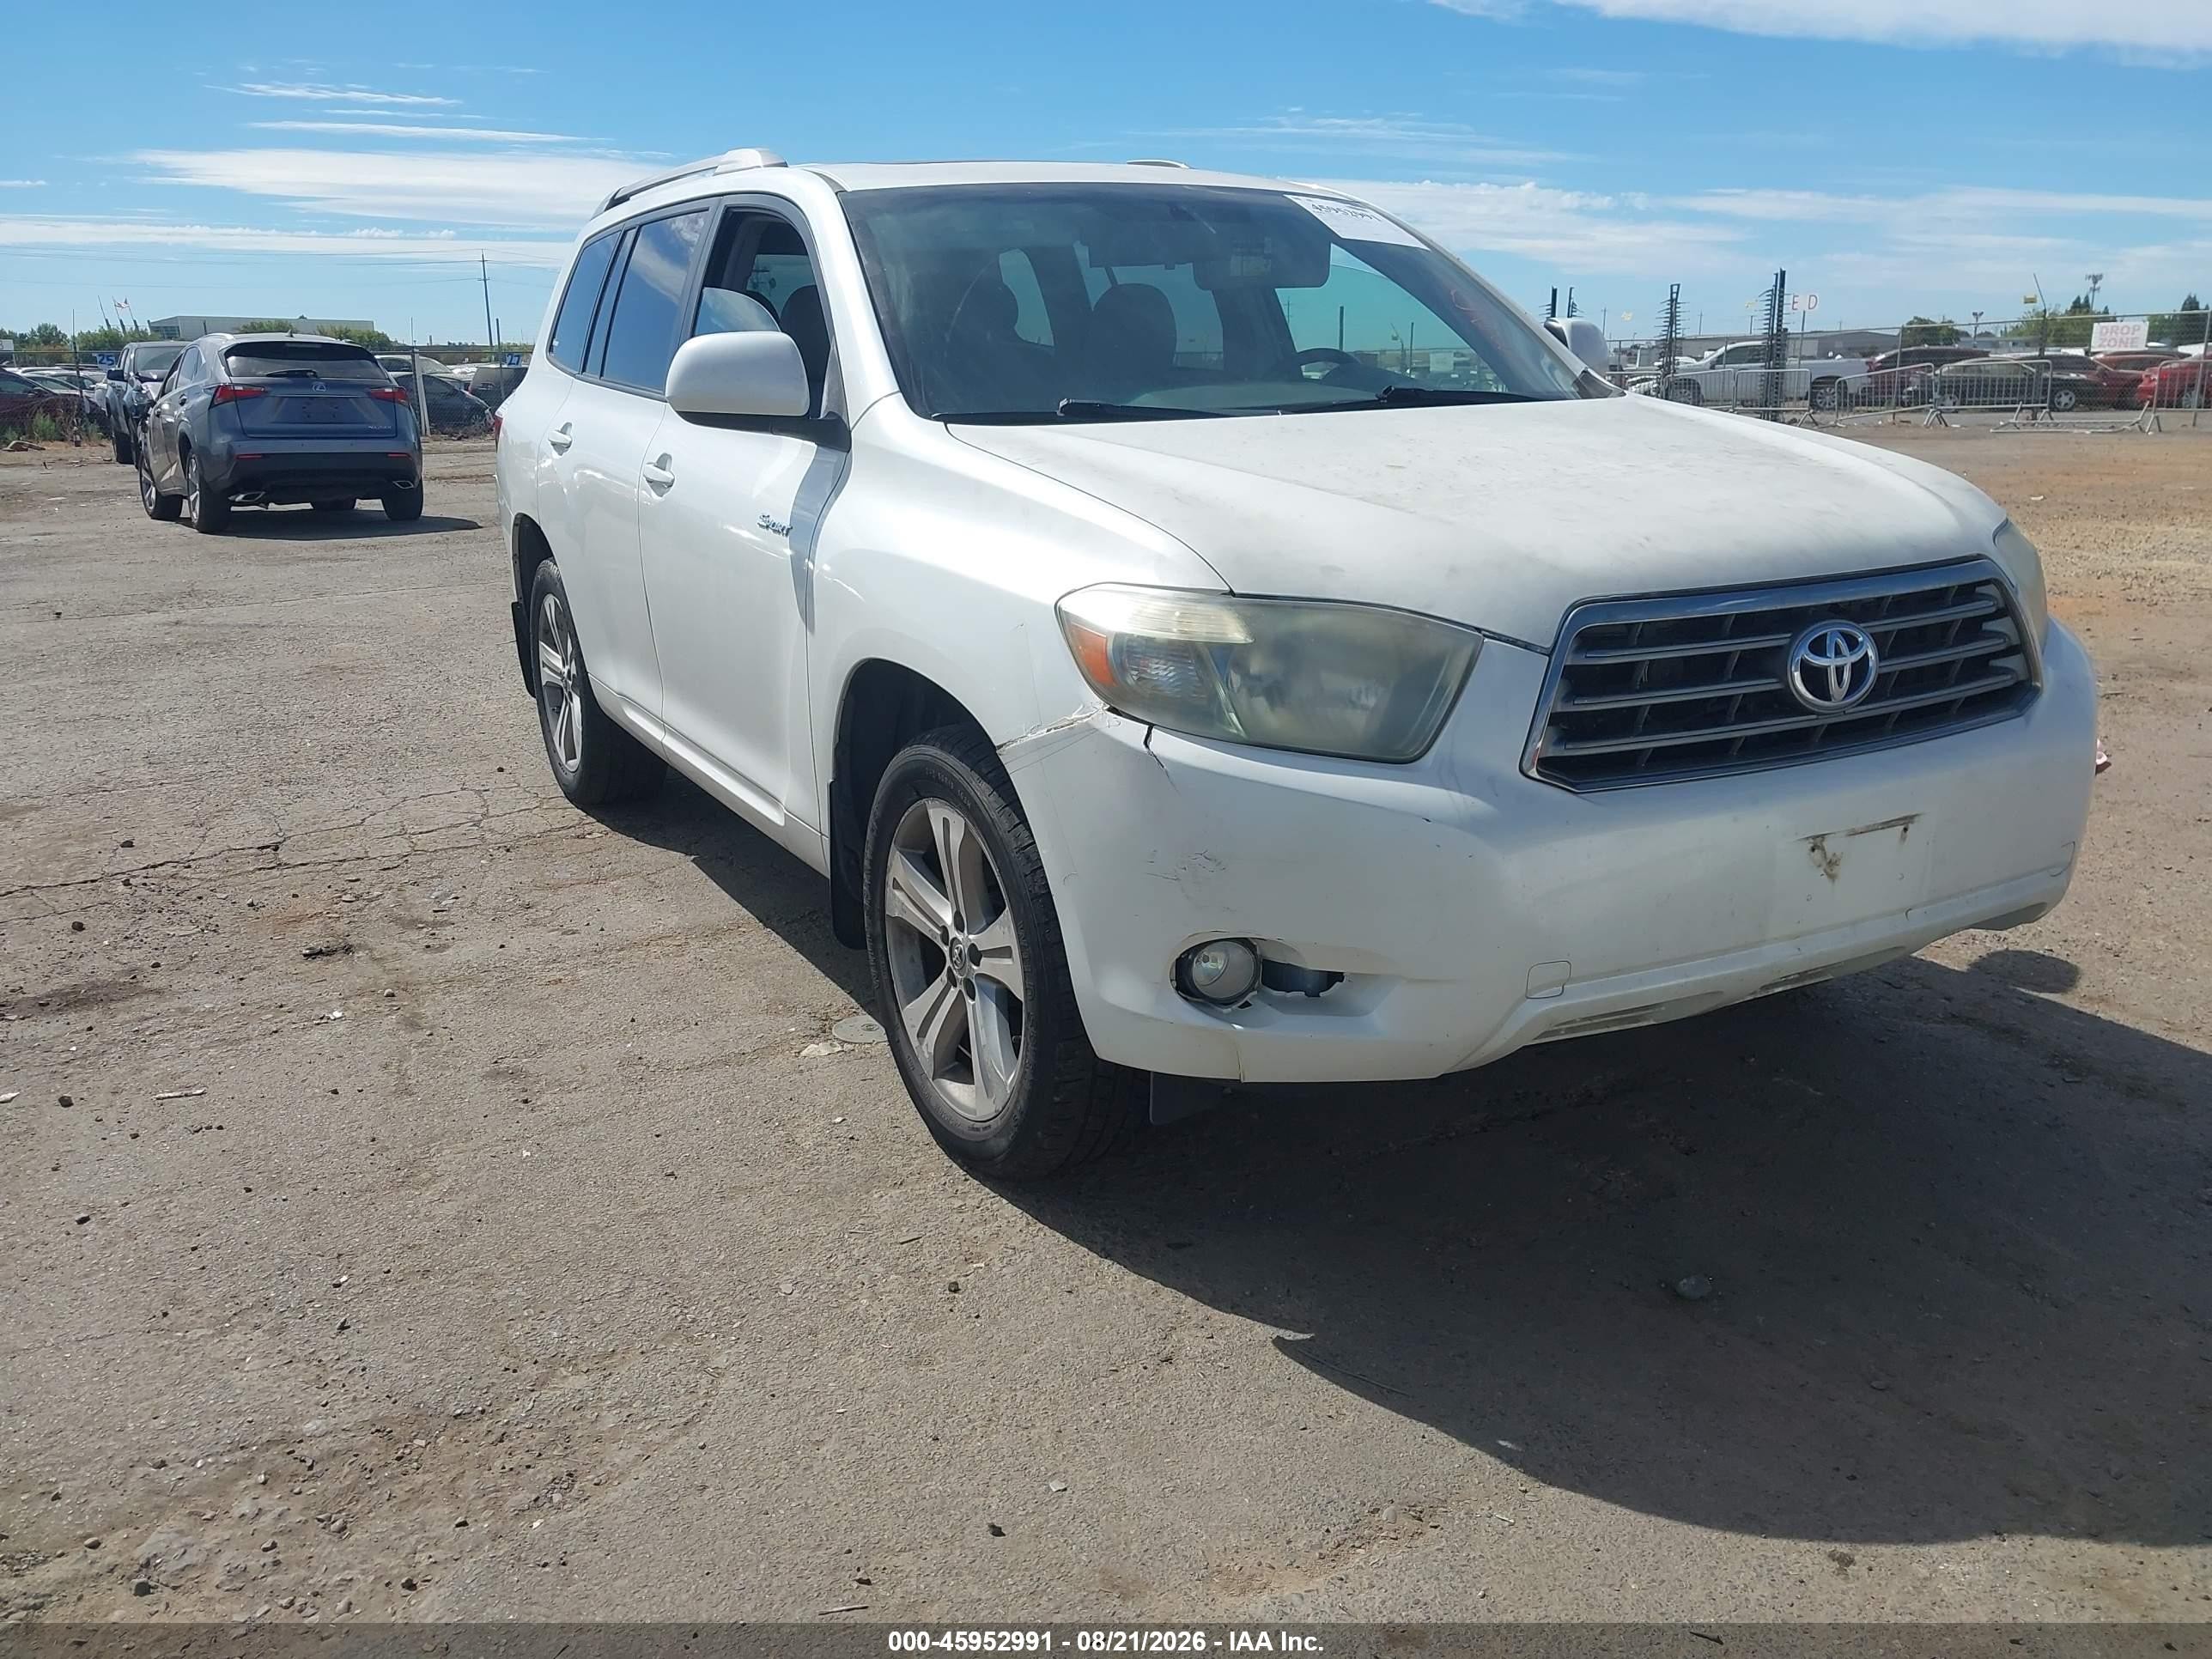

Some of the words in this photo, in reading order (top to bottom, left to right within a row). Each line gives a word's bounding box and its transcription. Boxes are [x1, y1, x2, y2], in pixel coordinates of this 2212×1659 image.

[2100, 324, 2141, 337] DROP
[2098, 336, 2140, 349] ZONE
[97, 353, 115, 366] 25
[507, 352, 520, 366] 27
